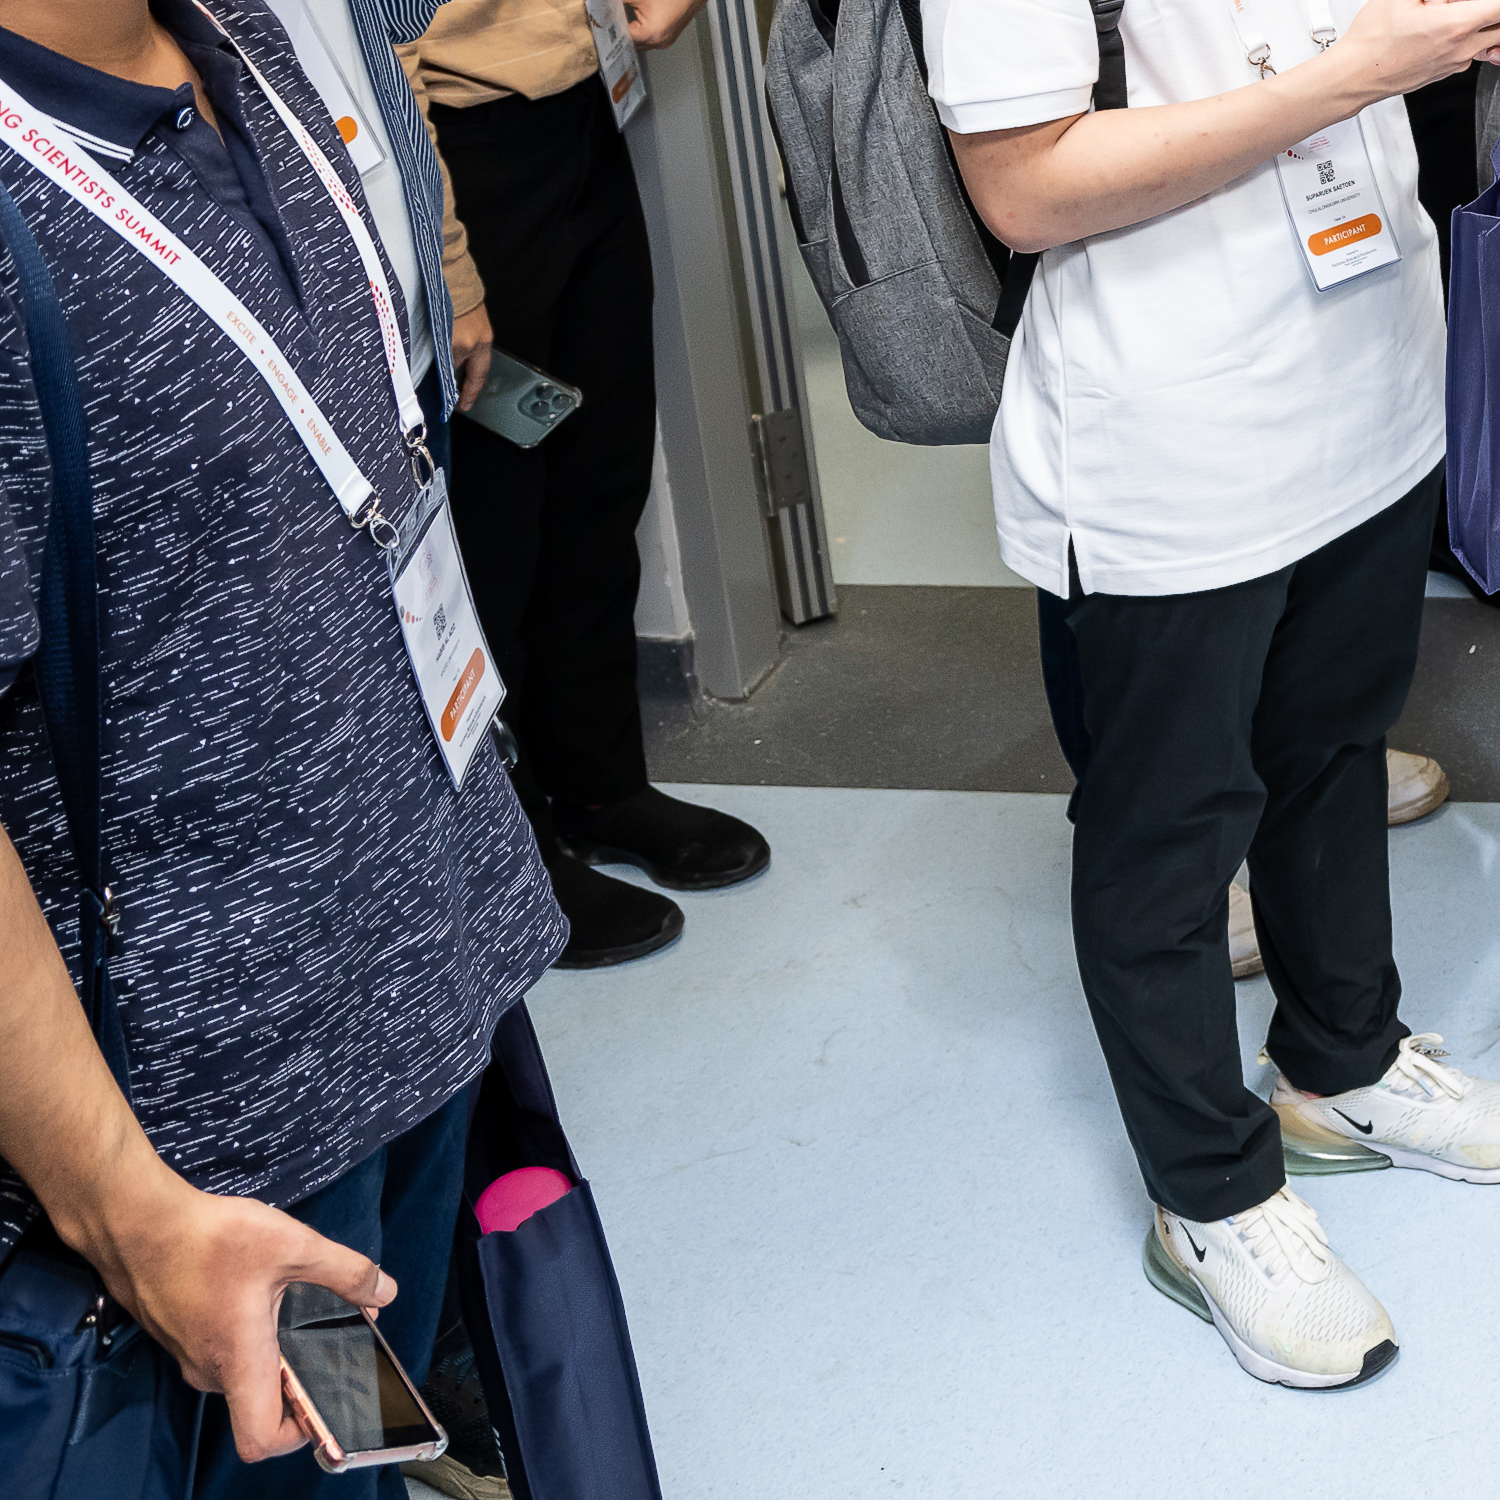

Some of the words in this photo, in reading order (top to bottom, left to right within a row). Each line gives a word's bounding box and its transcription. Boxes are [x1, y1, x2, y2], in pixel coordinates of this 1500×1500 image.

[22, 128, 115, 208] SCIENTISTS
[115, 208, 182, 265] SUMMIT
[1323, 223, 1367, 246] PARTICIPANT
[226, 310, 257, 345] EXCITE
[267, 359, 299, 405] ENGAGE
[306, 418, 332, 456] ENABLE
[449, 668, 476, 722] PARTICIPANT
